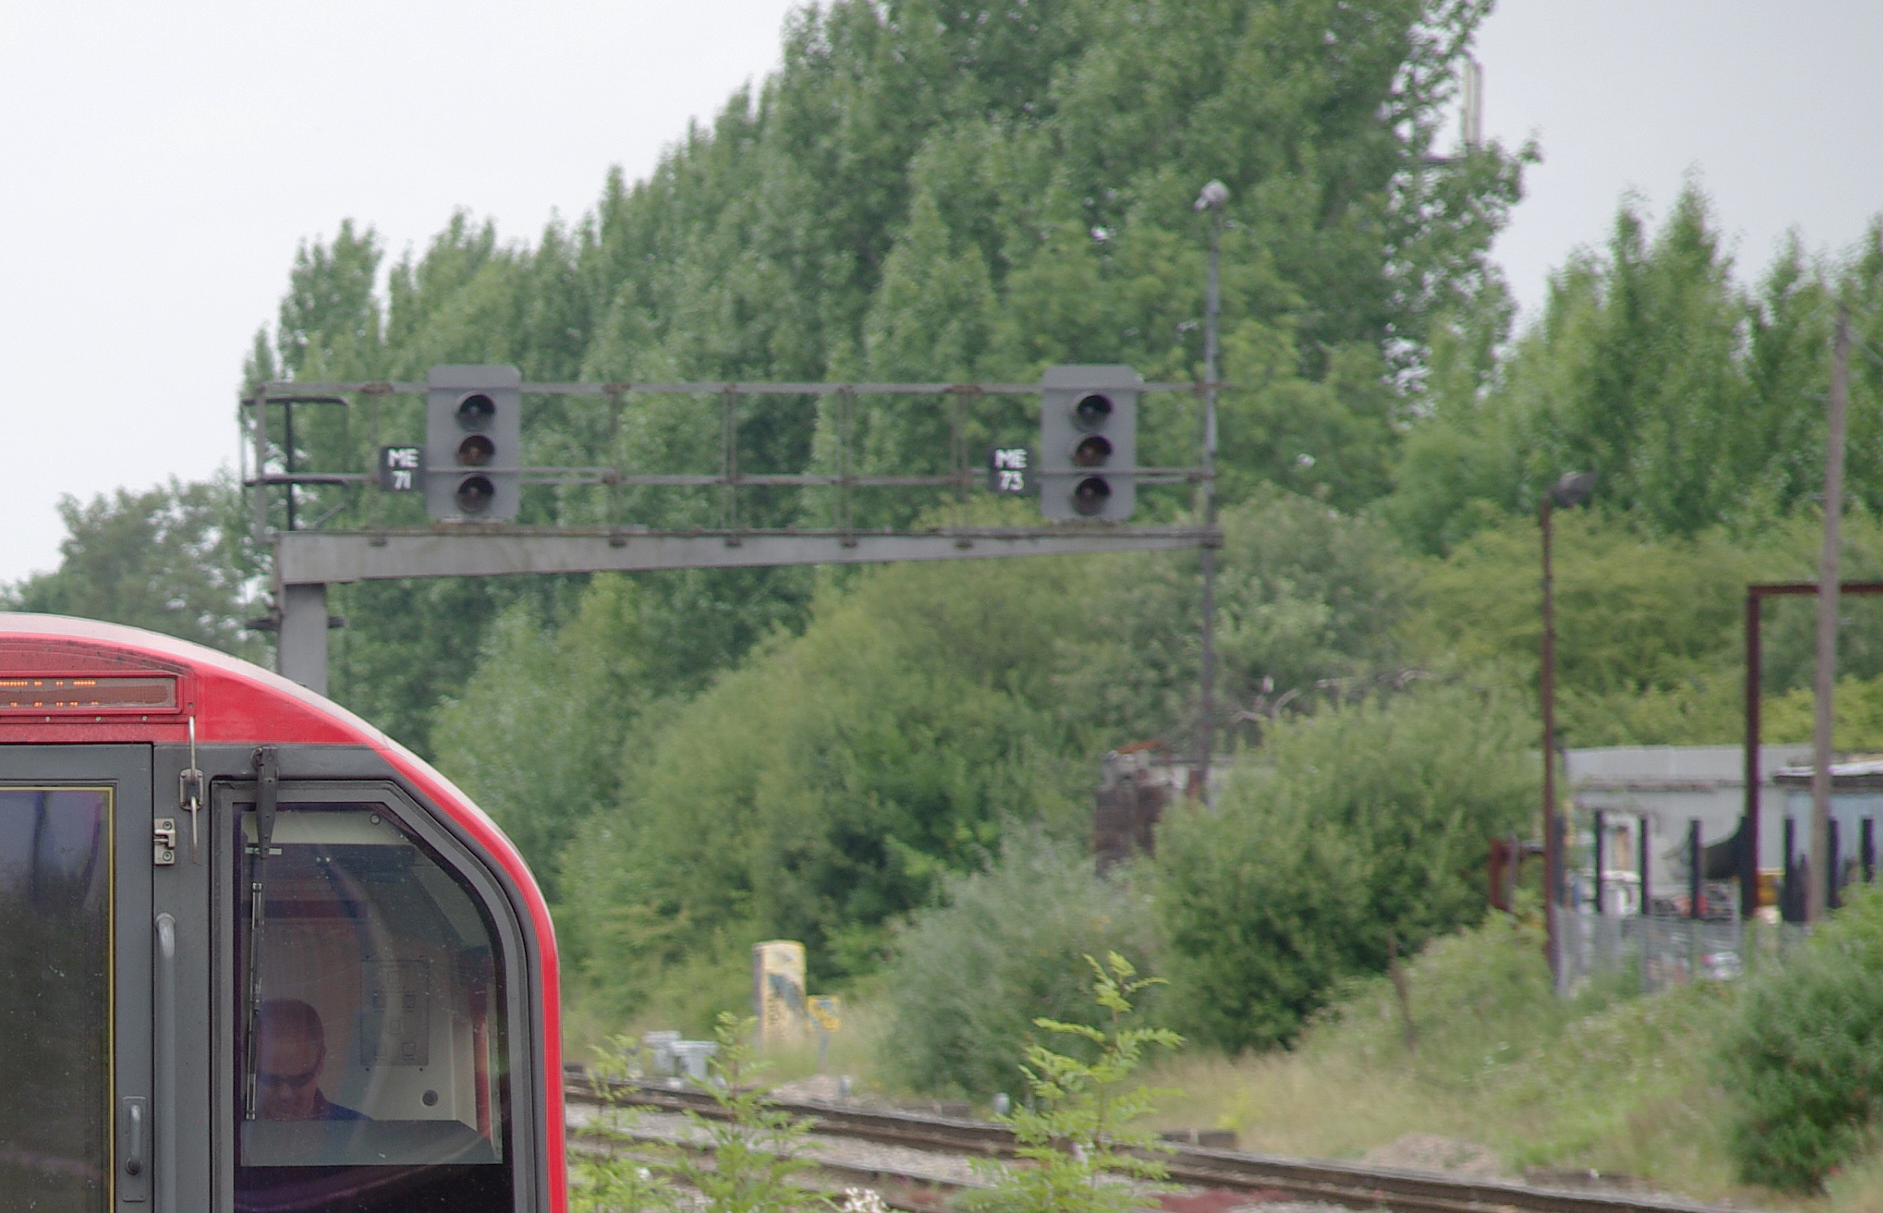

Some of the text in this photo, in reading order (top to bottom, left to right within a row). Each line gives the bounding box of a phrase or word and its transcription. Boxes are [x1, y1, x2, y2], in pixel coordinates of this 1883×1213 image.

[388, 448, 419, 468] ME
[995, 448, 1027, 468] ME
[392, 470, 411, 490] 71
[999, 470, 1024, 490] 73
